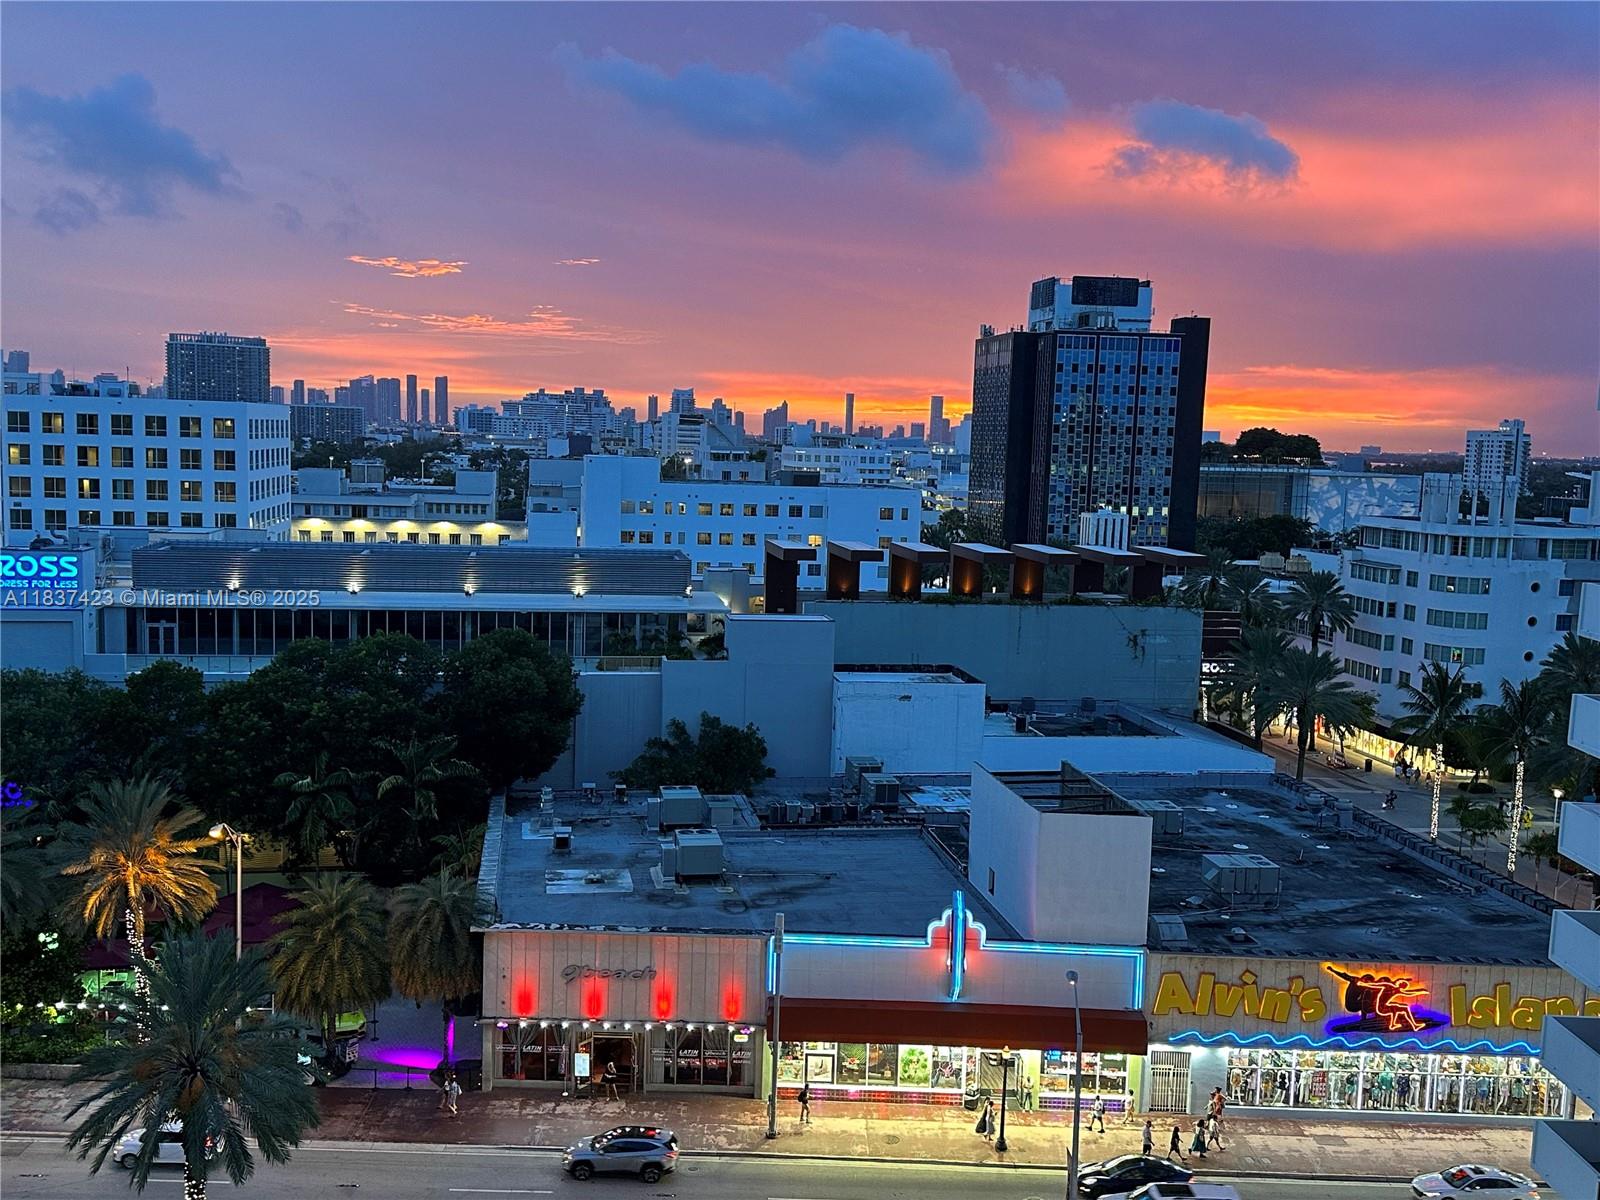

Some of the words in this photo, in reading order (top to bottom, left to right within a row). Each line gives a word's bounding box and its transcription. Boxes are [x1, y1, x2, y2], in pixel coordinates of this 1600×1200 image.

[0, 555, 78, 577] ROSS
[32, 580, 51, 588] FOR
[54, 580, 78, 588] LESS
[1152, 969, 1327, 1023] Alvin's
